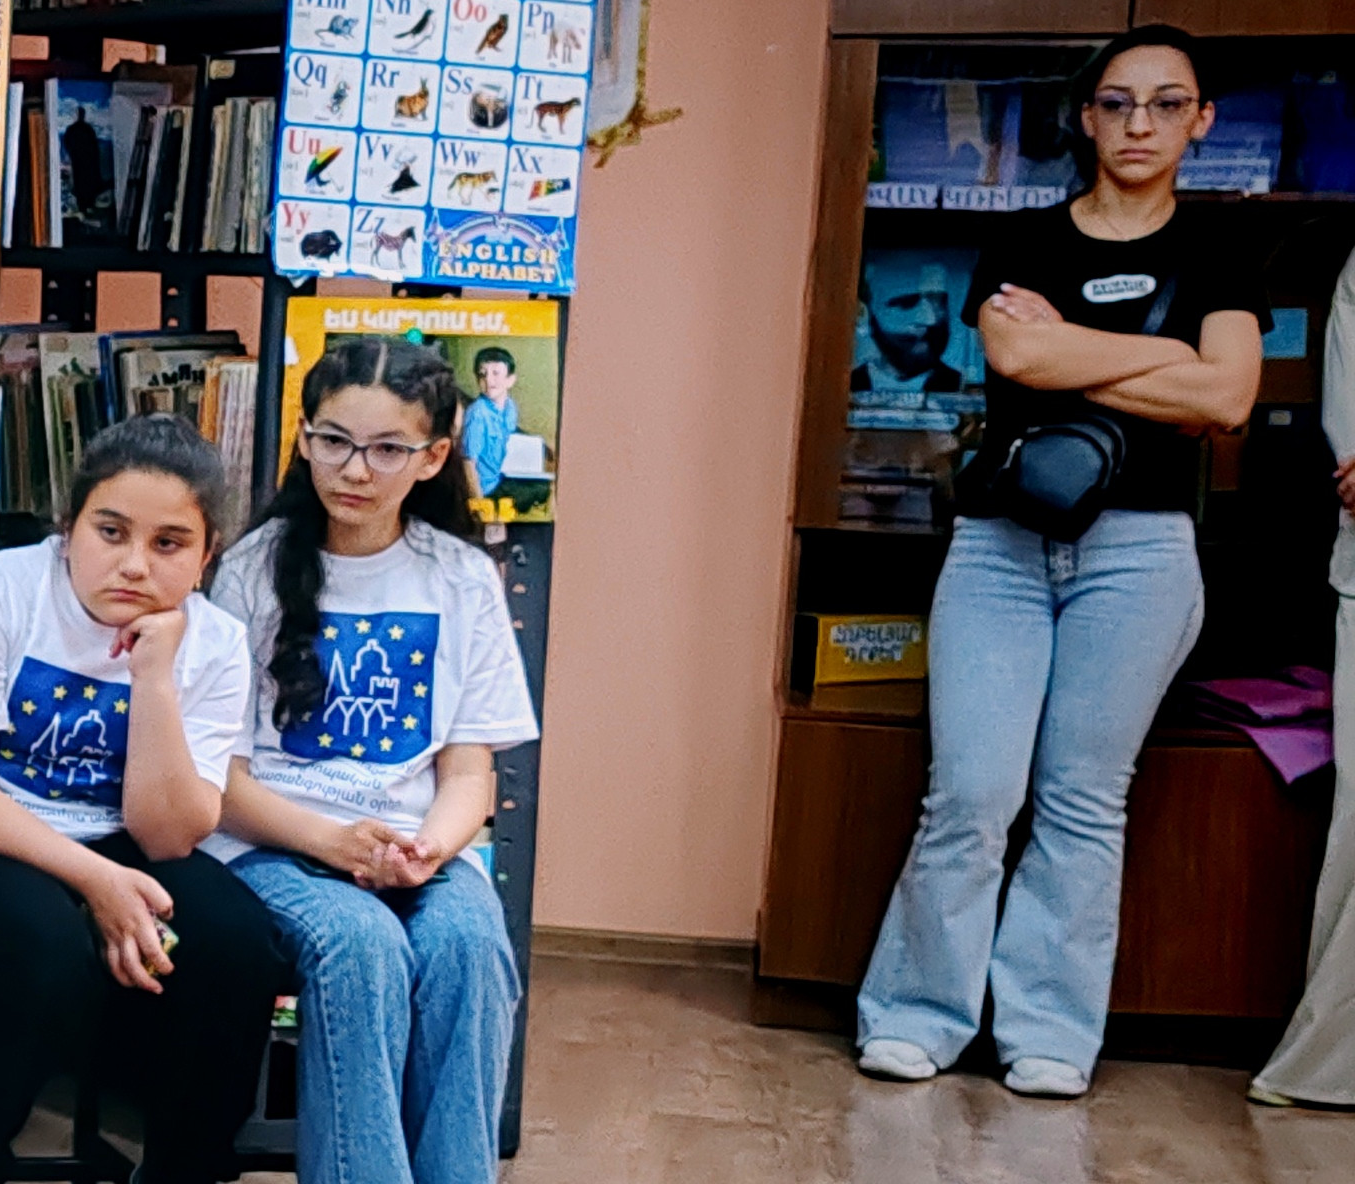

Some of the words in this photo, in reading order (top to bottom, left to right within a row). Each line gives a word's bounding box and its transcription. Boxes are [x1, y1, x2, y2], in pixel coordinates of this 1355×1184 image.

[527, 2, 555, 35] Pp
[293, 55, 327, 88] Qq
[370, 62, 400, 88] Rr
[446, 69, 473, 95] Ss
[521, 75, 544, 100] Tt
[288, 129, 322, 155] Uu
[364, 135, 393, 161] Vv
[440, 141, 481, 167] Ww
[512, 148, 543, 174] Xx
[281, 202, 310, 234] Yy
[356, 208, 384, 233] Zz
[439, 241, 557, 265] ENGLISH
[438, 261, 556, 284] ALPHABET
